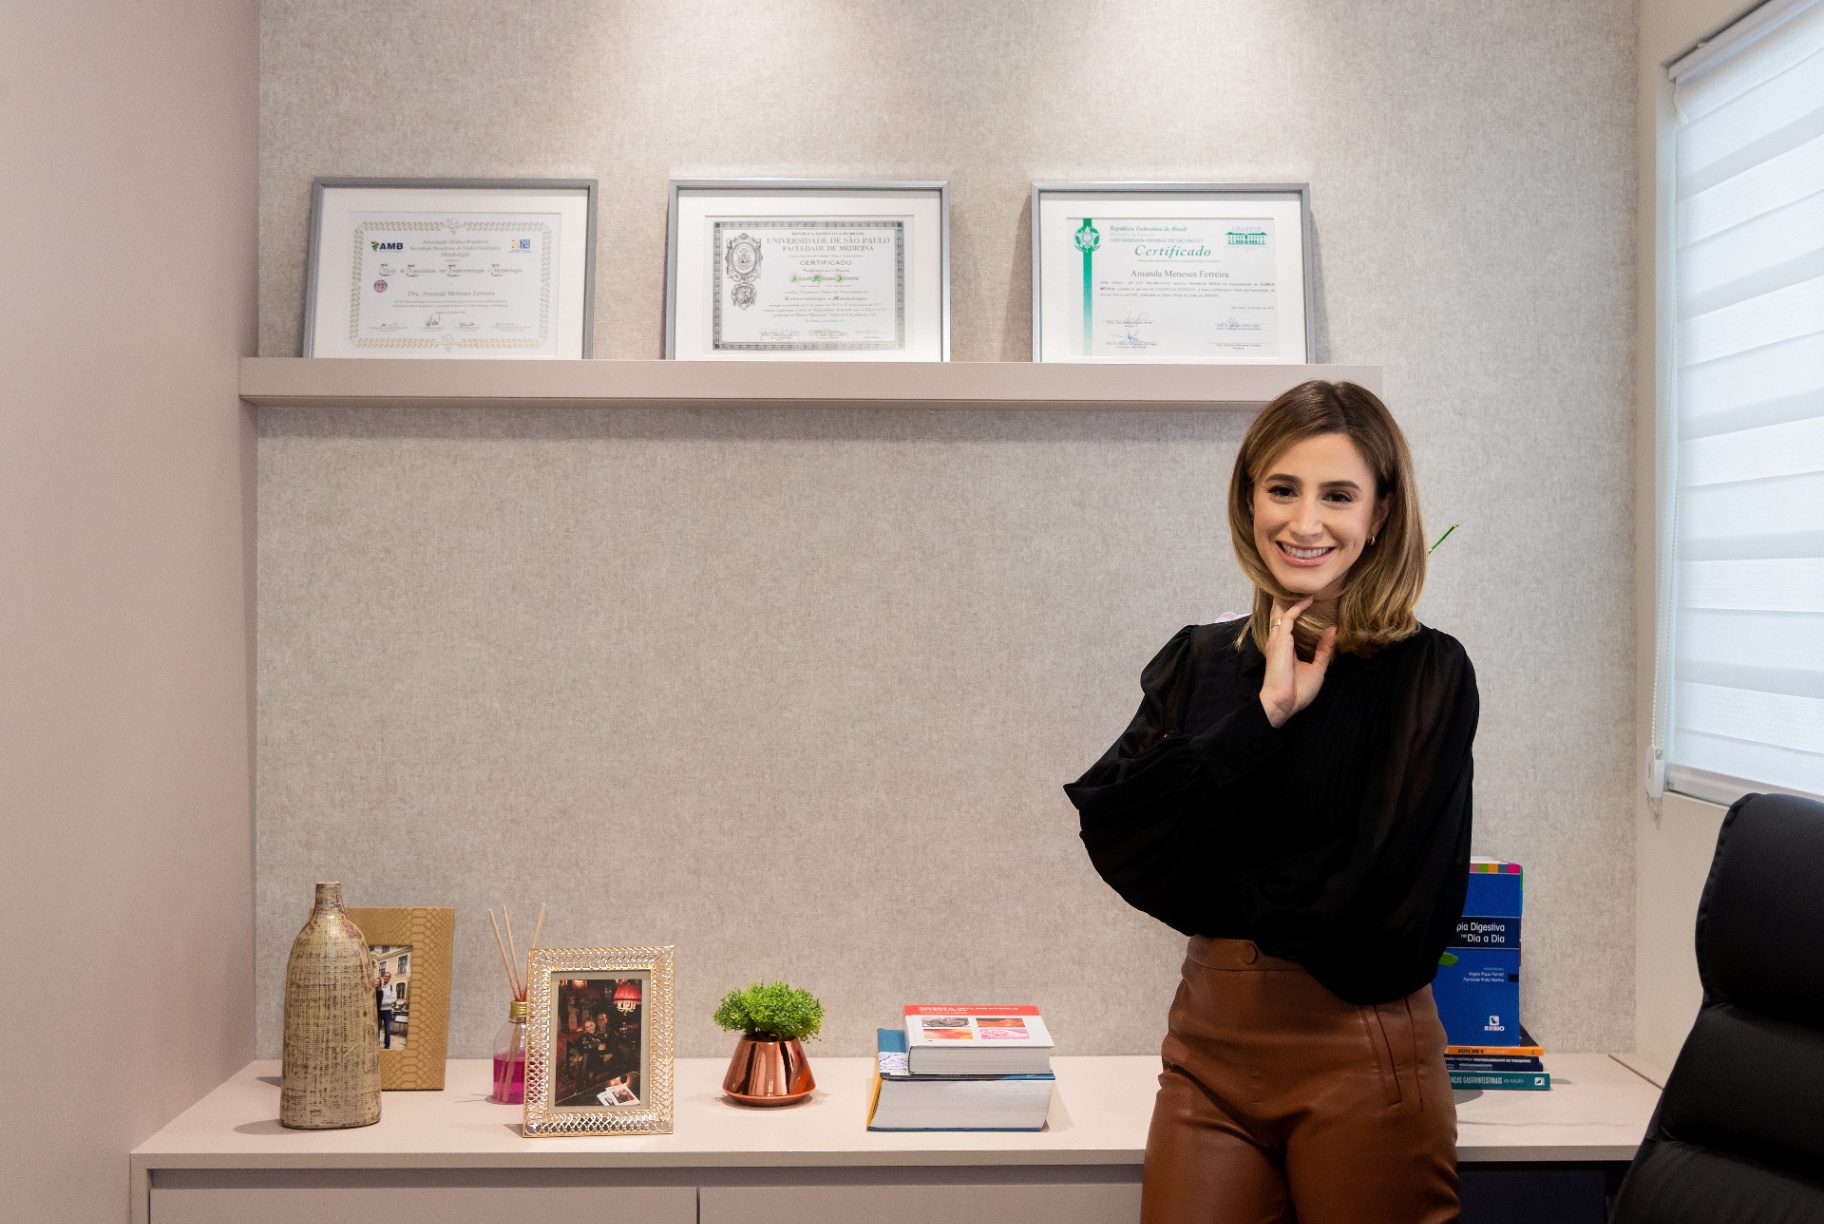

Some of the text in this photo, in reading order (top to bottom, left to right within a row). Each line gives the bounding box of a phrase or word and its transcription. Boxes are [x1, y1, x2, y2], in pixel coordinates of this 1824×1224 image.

[844, 236, 860, 244] SÃO
[379, 242, 404, 251] AMB
[1134, 245, 1211, 258] Certificado
[1130, 270, 1229, 278] Amanda Meneses Ferreira
[1470, 922, 1505, 933] Digestiva
[1467, 933, 1481, 943] Dia
[1483, 935, 1489, 943] a
[1491, 934, 1505, 943] Dia
